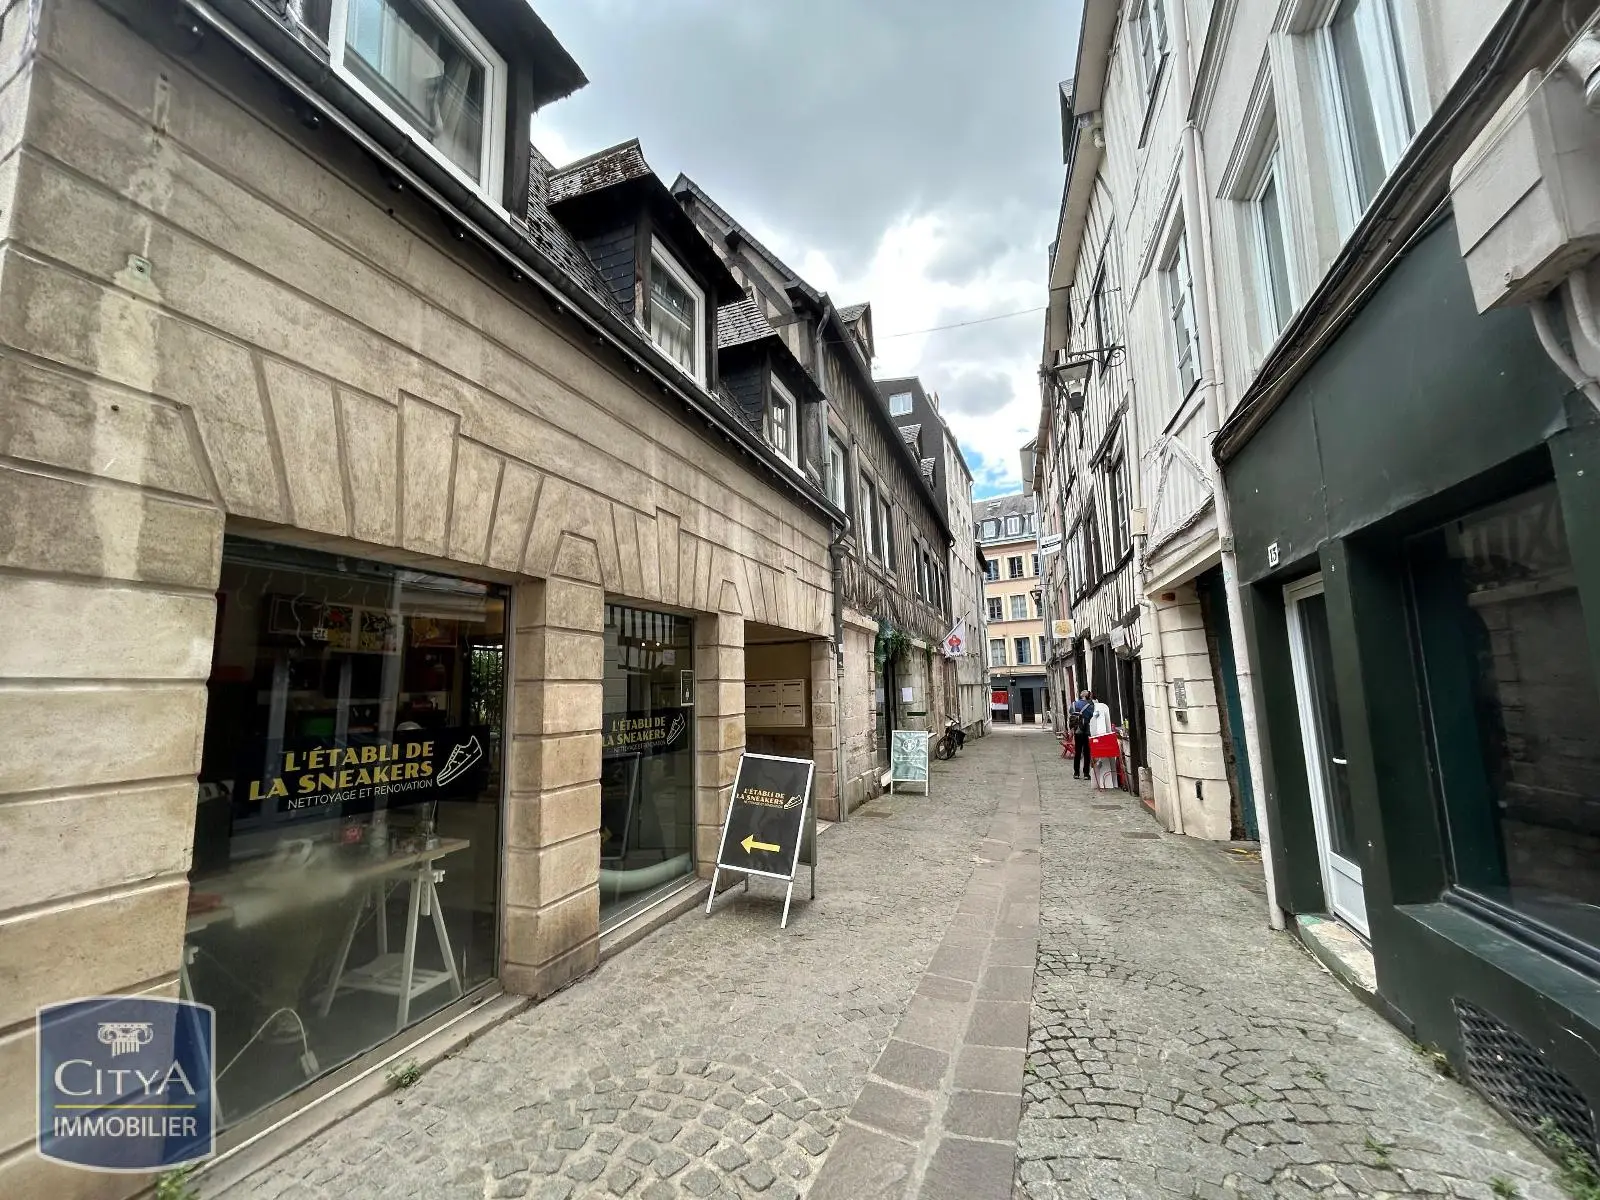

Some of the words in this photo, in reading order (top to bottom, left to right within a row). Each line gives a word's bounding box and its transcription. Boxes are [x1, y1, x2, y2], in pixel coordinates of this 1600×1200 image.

[612, 716, 653, 732] L'ÉTABLI
[654, 716, 666, 727] DE
[602, 734, 615, 747] LA
[616, 728, 666, 745] SNEAKERS
[285, 743, 400, 772] L'ÉTABLI
[405, 740, 435, 759] DE
[249, 777, 289, 801] LA
[297, 760, 433, 794] SNEAKERS
[287, 788, 356, 810] NETTOYAGE
[359, 787, 373, 799] ET
[374, 778, 433, 796] RENOVATION
[746, 794, 784, 805] SNEAKERS
